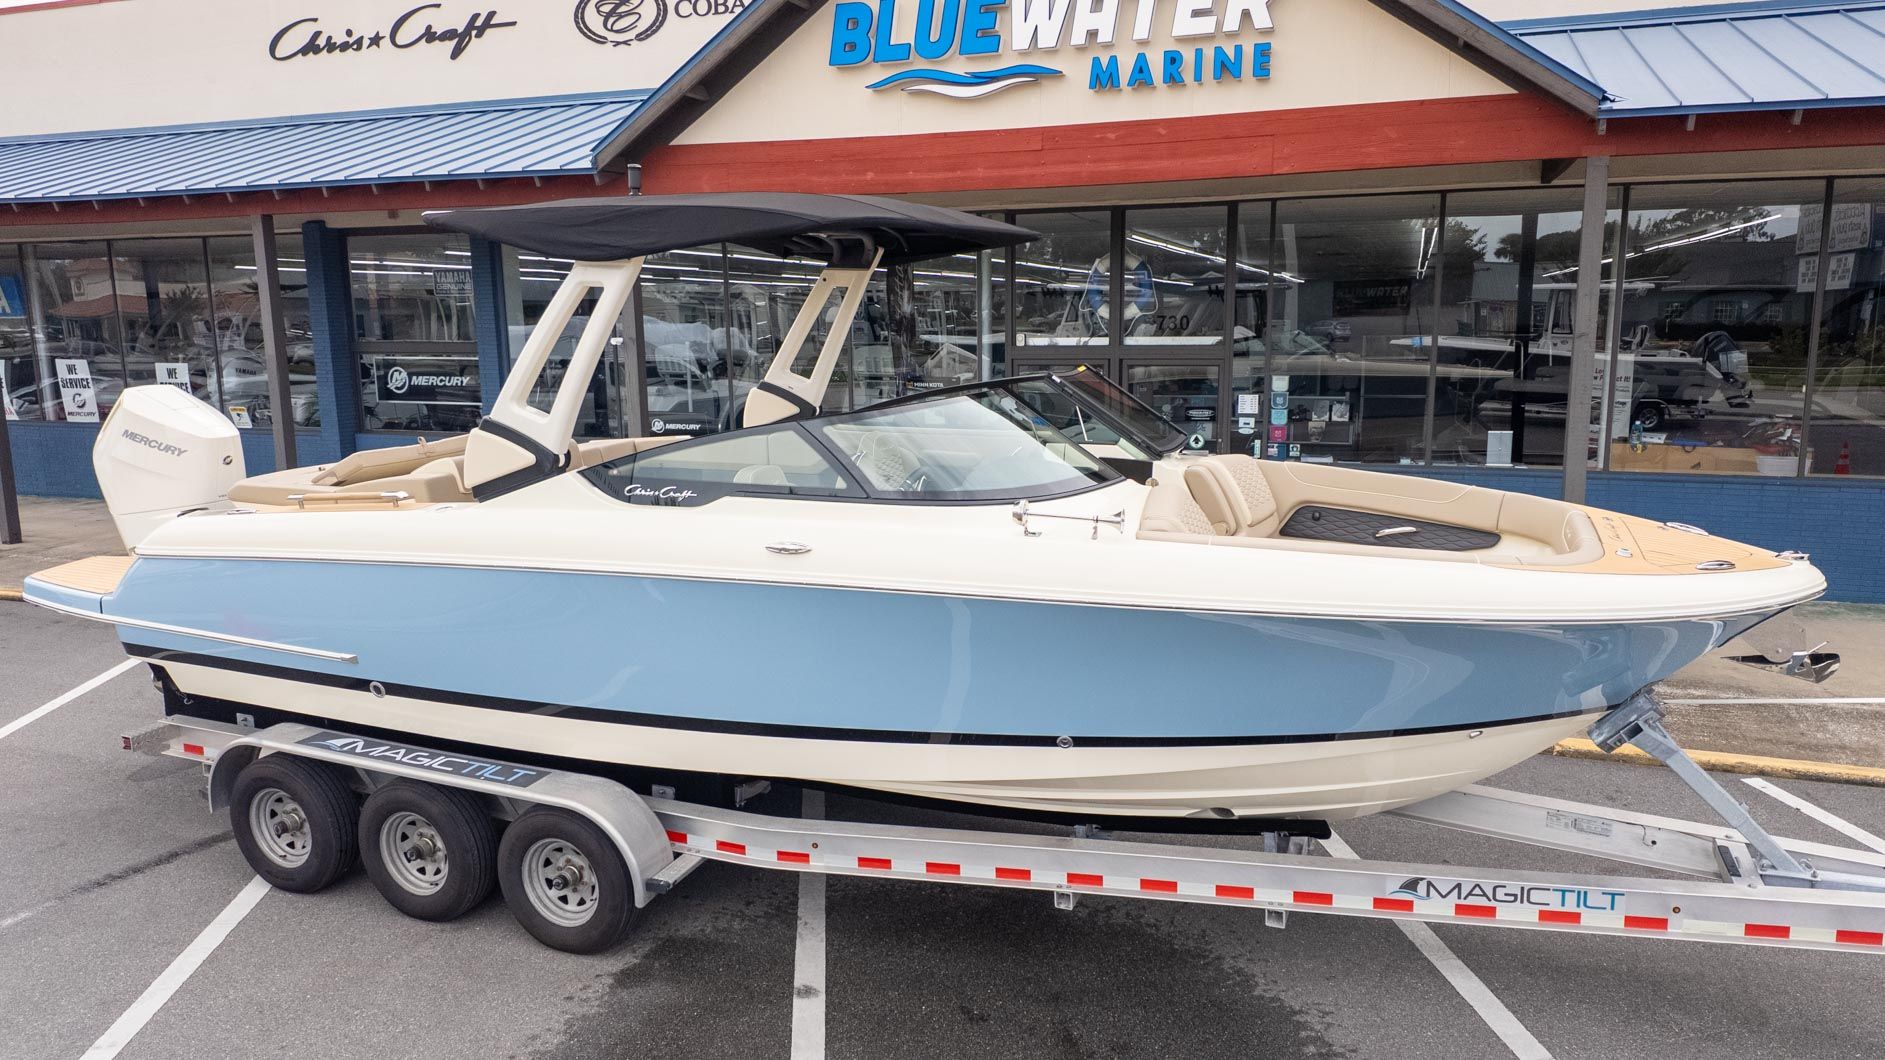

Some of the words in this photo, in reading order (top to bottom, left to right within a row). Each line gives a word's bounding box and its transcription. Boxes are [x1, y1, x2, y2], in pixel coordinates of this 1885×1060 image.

[268, 17, 365, 61] Chris
[389, 3, 518, 60] Craft
[1088, 42, 1272, 91] MARINE
[434, 271, 471, 282] YAMAHA
[66, 364, 78, 375] WE
[166, 367, 178, 379] WE
[60, 377, 92, 389] SERVICE
[411, 375, 470, 386] MERCURY
[122, 429, 188, 457] MERCURY
[659, 486, 697, 501] Craft
[343, 738, 536, 782] MAGICTILT
[1426, 880, 1625, 911] MAGICTILT
